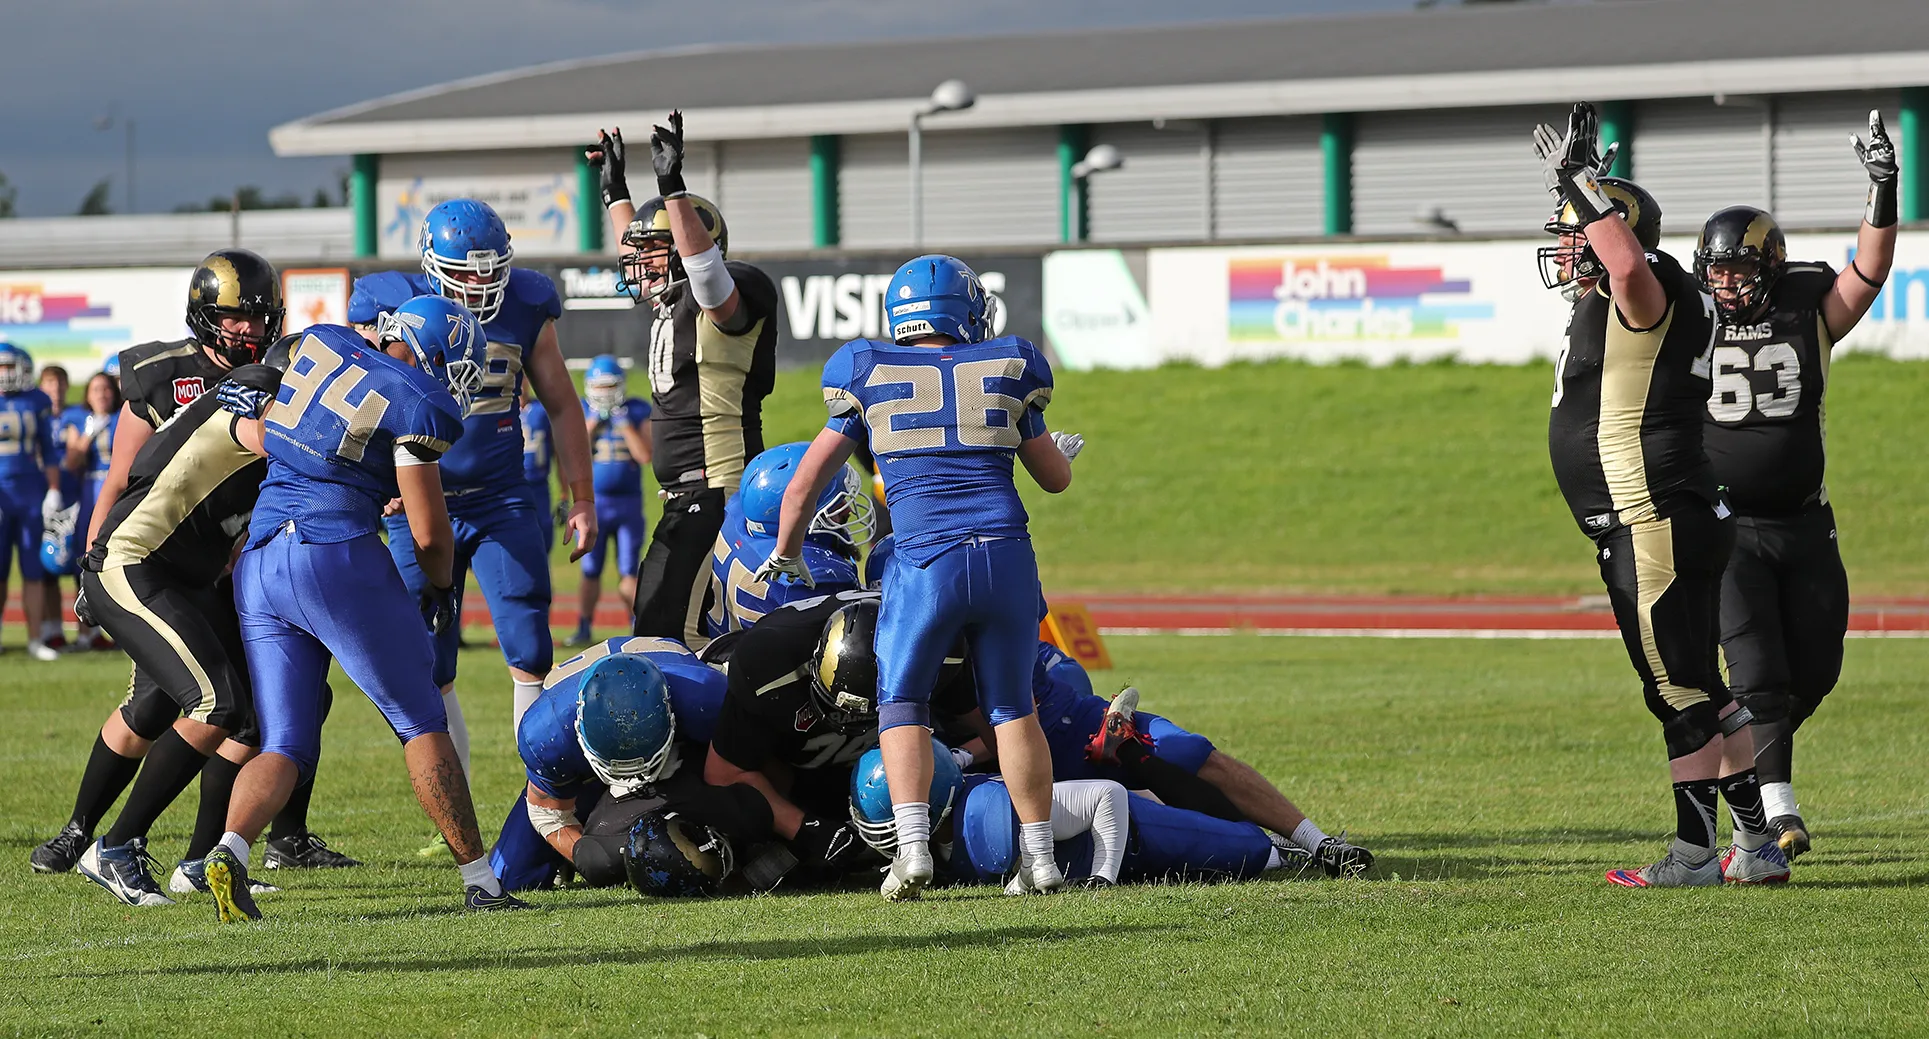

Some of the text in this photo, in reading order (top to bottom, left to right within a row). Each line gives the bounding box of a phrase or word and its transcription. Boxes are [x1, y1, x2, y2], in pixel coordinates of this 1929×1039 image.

[780, 272, 1008, 341] VISITS
[1273, 260, 1367, 300] John
[1273, 298, 1414, 339] Charles
[1723, 321, 1773, 342] RAMS
[177, 382, 201, 400] MOD
[264, 332, 391, 463] 94
[863, 357, 1028, 456] 26
[1705, 341, 1803, 423] 63
